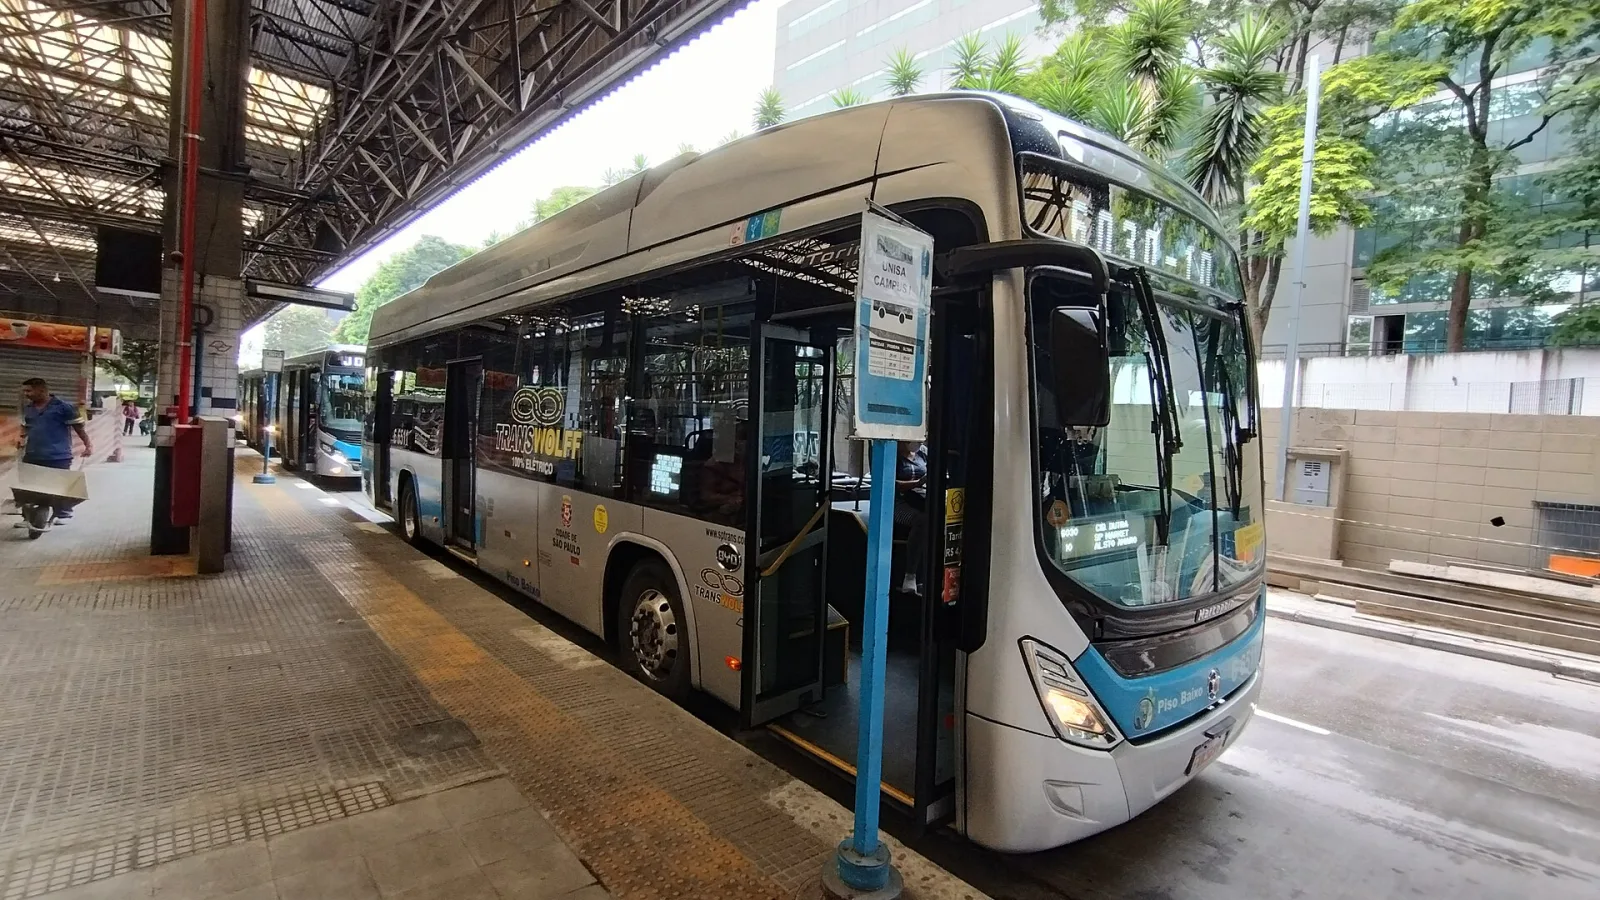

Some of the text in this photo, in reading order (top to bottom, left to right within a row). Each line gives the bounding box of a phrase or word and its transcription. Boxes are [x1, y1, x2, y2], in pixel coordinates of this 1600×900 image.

[806, 243, 860, 266] Torin
[882, 261, 907, 277] UNISA
[873, 275, 907, 293] CAMPUS
[495, 423, 582, 459] TRANSWOLFF
[511, 456, 553, 475] 100% ELÉTRICO
[1108, 520, 1129, 530] DUTRA
[555, 528, 577, 543] CIDADE DE
[563, 541, 581, 556] PAULO
[718, 550, 738, 566] BYD
[521, 577, 541, 598] Baixo
[694, 585, 744, 614] TRANSWOLF
[1157, 687, 1204, 714] Piso Baixo
